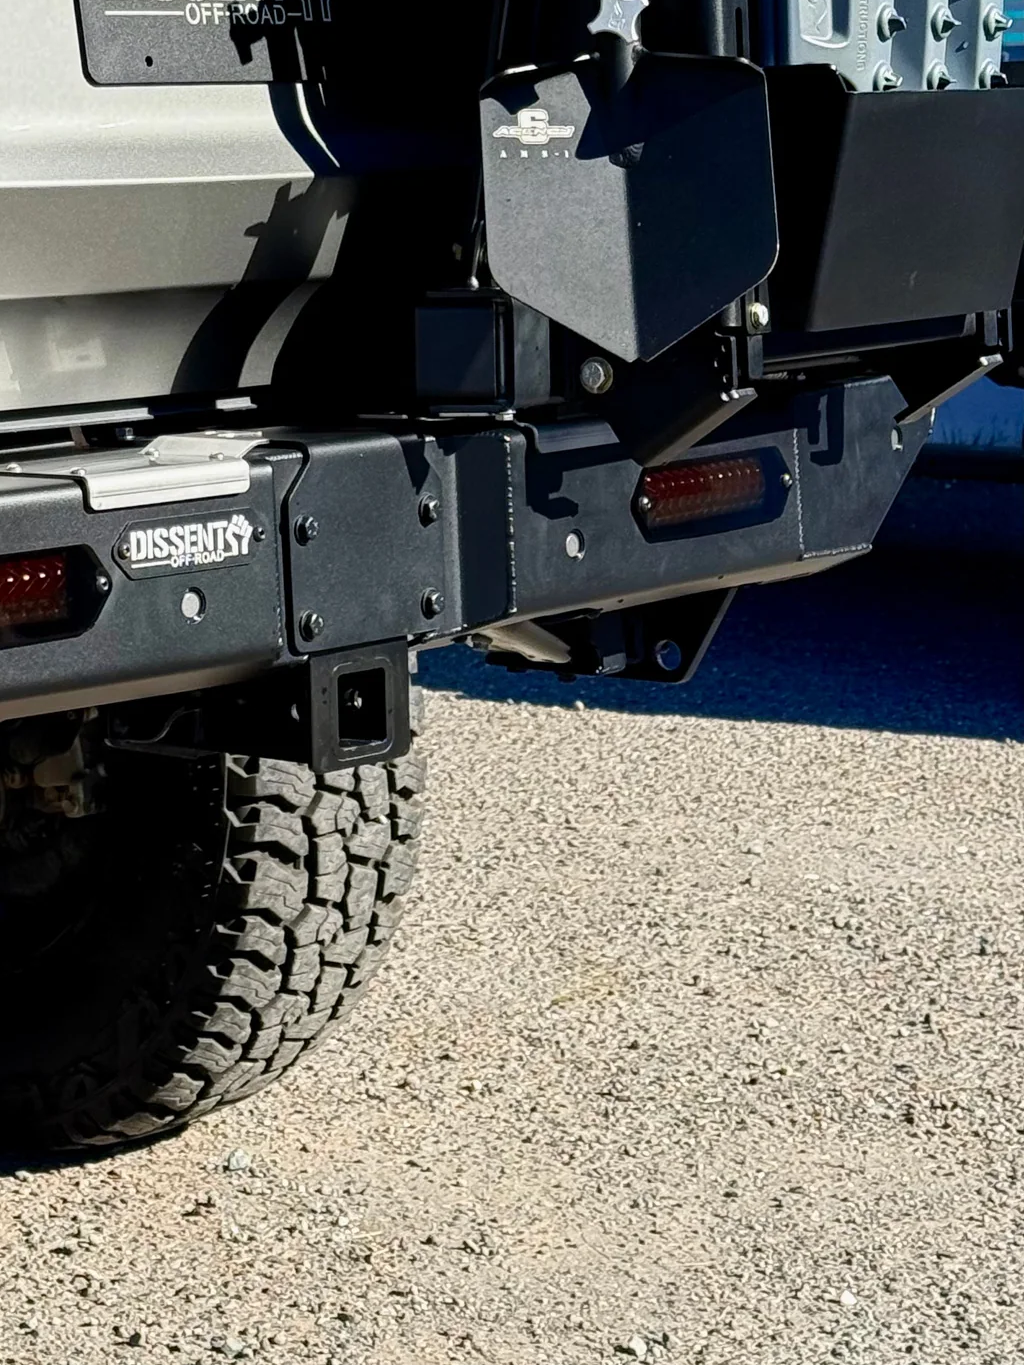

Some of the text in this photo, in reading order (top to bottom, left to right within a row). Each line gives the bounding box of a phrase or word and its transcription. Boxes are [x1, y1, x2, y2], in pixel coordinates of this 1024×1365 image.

[185, 2, 287, 26] OFF-ROAD
[130, 520, 229, 562] DISSENT
[171, 550, 225, 569] OFF-ROAD
